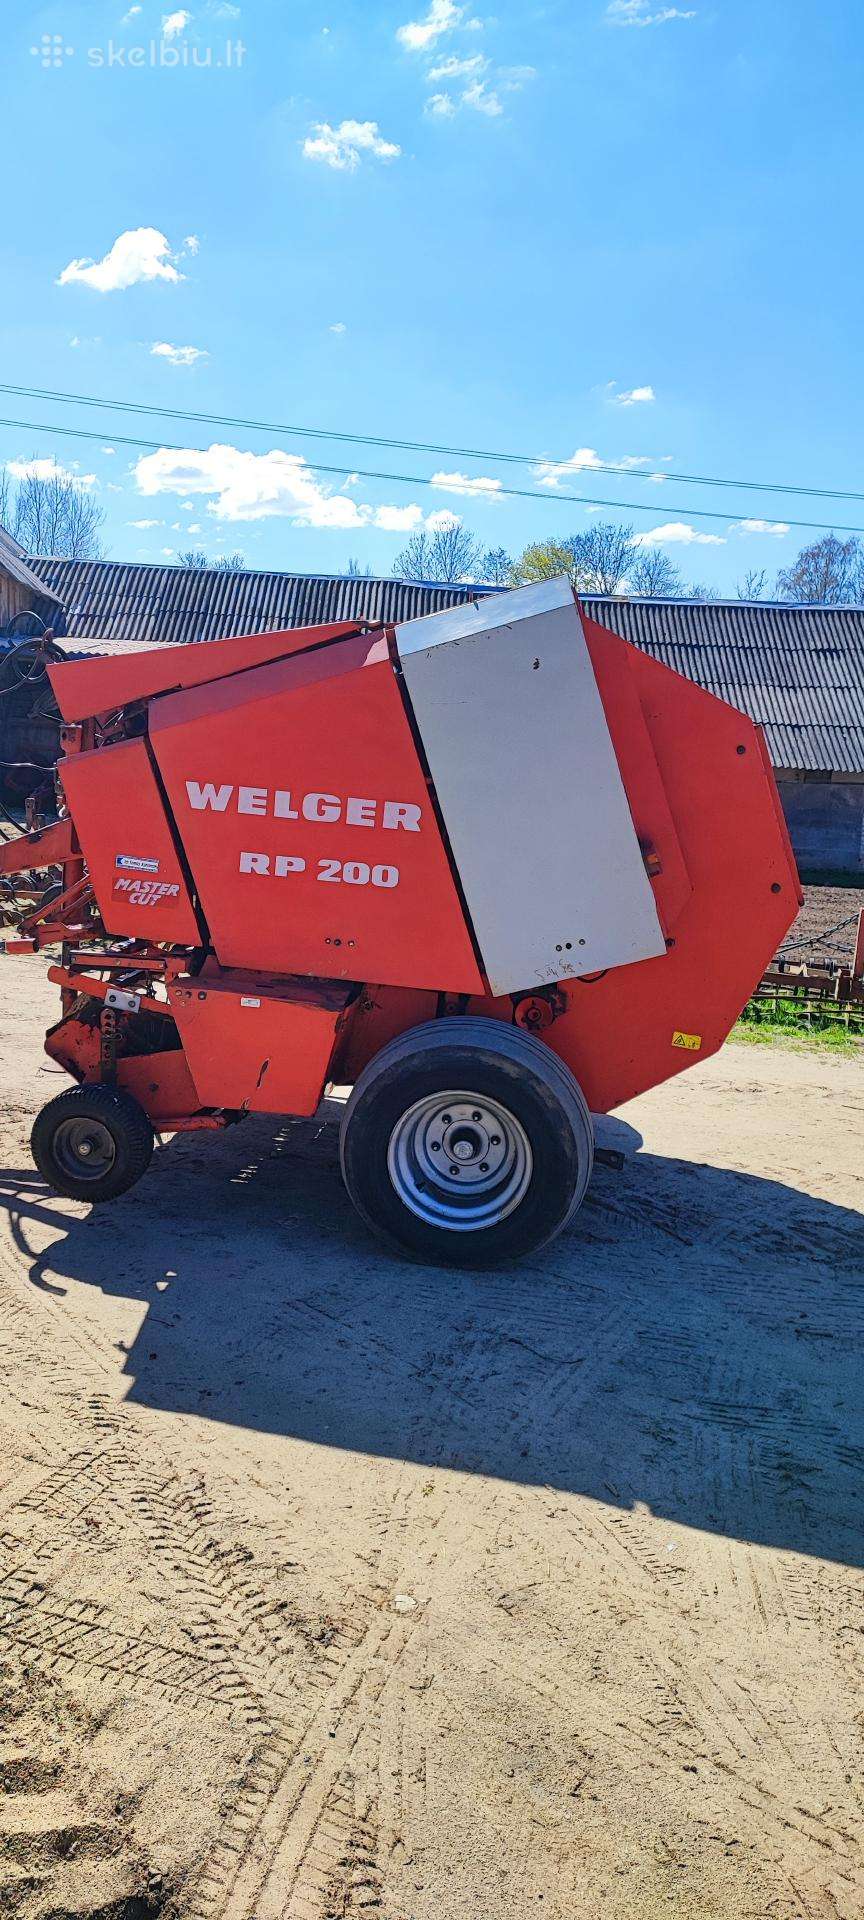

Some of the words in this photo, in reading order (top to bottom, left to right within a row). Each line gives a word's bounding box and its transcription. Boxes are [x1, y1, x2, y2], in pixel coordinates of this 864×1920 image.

[185, 781, 422, 832] WELGER
[239, 851, 305, 877] RP
[317, 859, 399, 888] 200
[114, 878, 180, 897] MASTER
[128, 892, 161, 906] CUT
